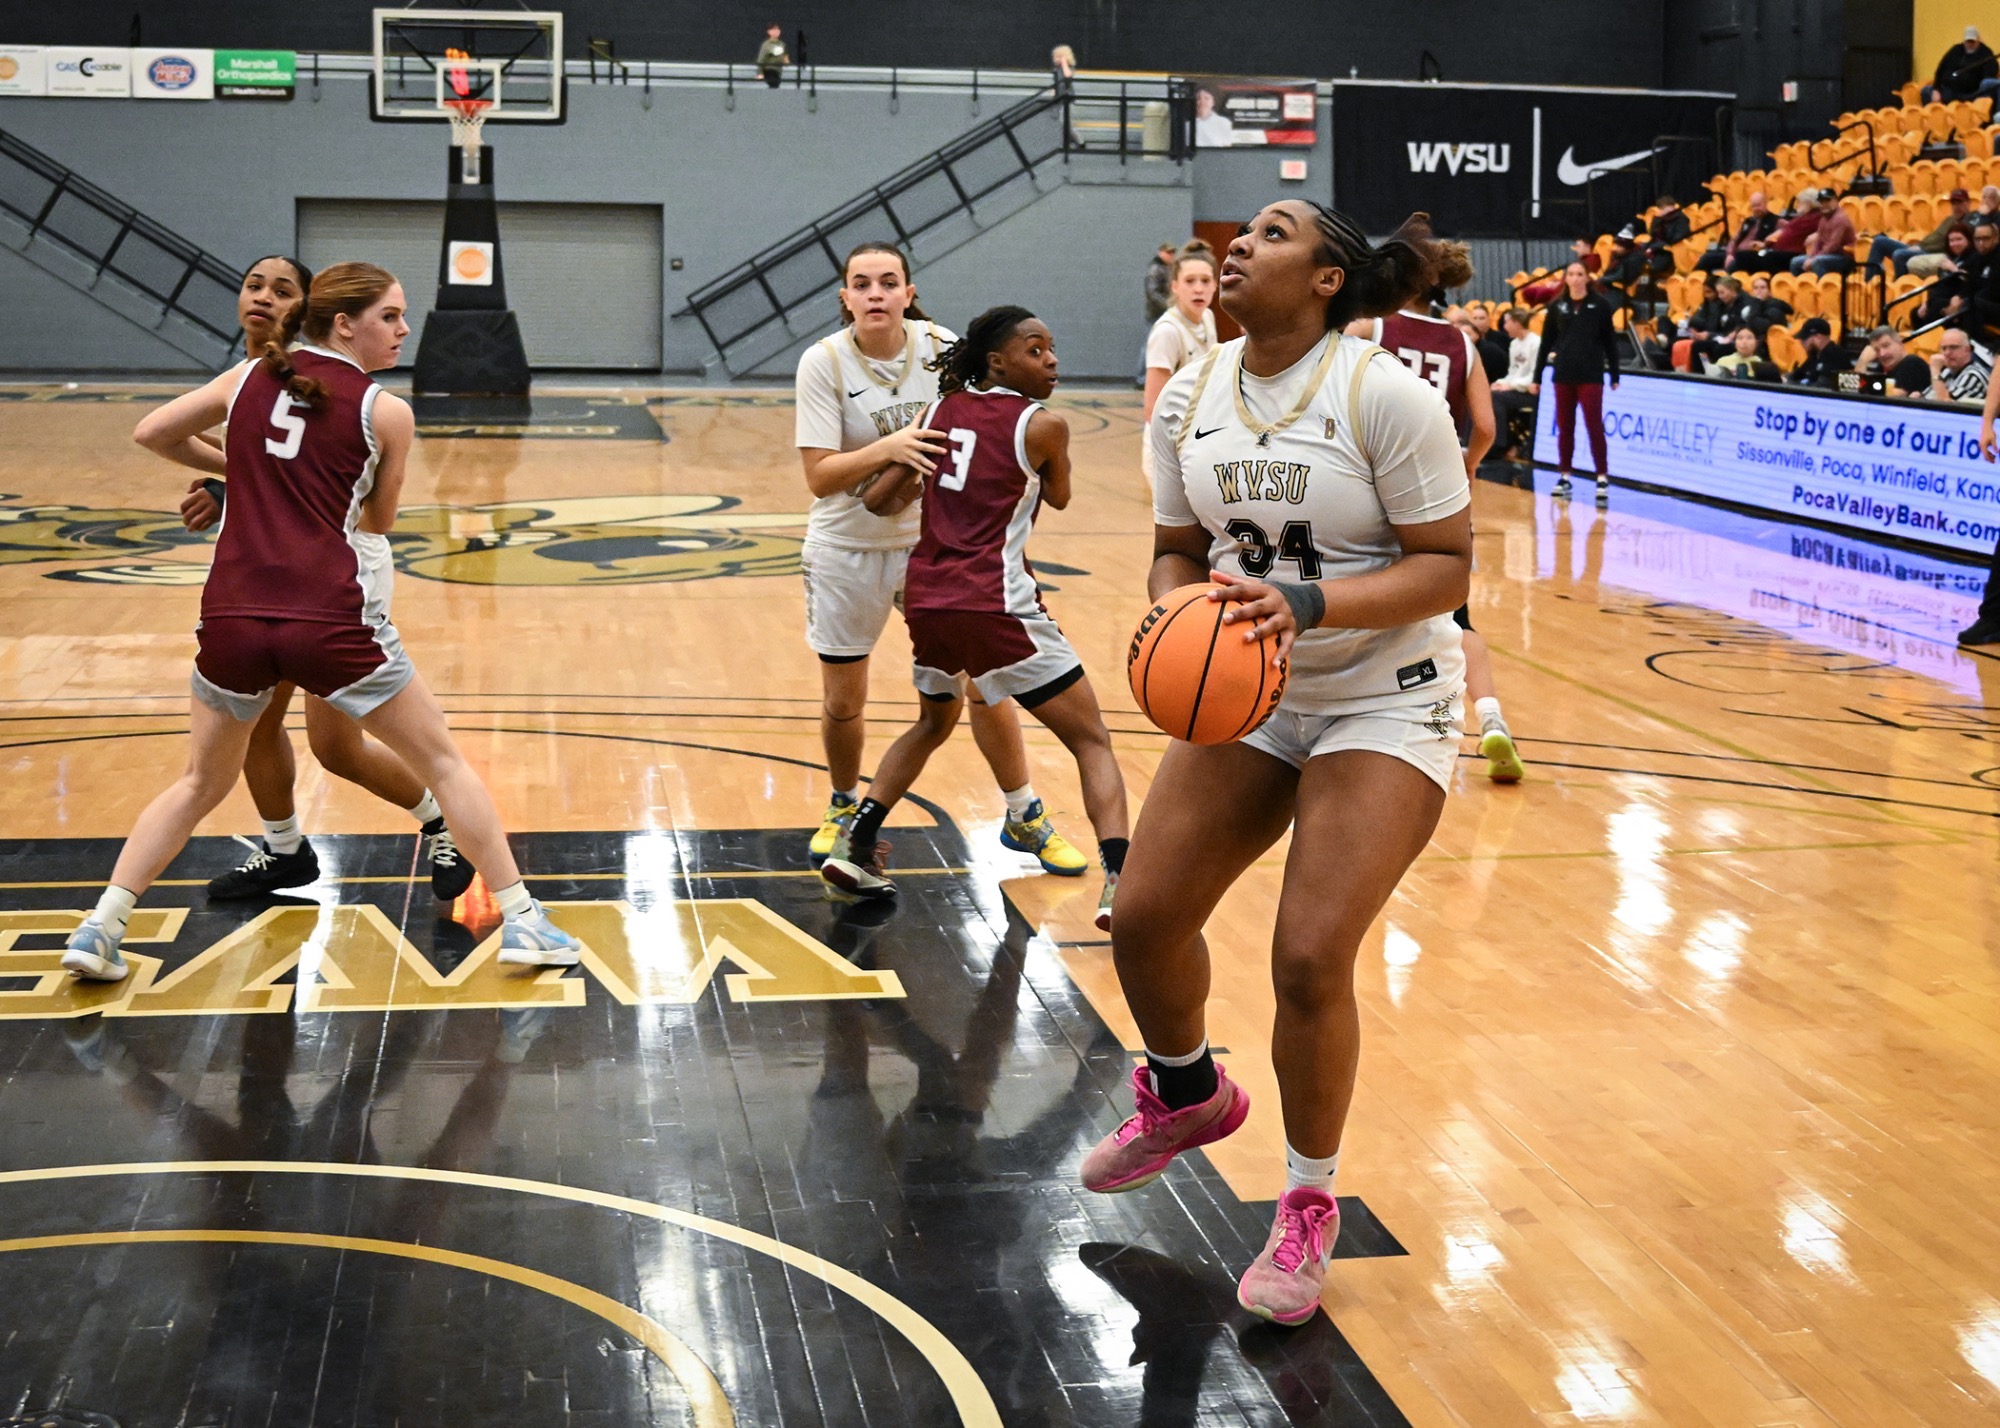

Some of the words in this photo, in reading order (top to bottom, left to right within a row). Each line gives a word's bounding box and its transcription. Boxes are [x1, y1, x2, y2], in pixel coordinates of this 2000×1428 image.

[231, 58, 278, 69] Marshall
[1407, 142, 1510, 176] WVSU
[265, 390, 311, 459] 5
[1755, 406, 1798, 440] Stop
[1804, 412, 1829, 444] by
[1835, 421, 1875, 444] one
[1882, 423, 1905, 449] of
[1911, 431, 1952, 456] our
[1958, 431, 1982, 460] lo
[939, 427, 977, 492] 3
[1214, 460, 1310, 505] WVSU
[1737, 441, 1817, 475] Sissonville,
[1822, 456, 1866, 485] Poca,
[1872, 463, 1951, 498] Winfield,
[1792, 485, 2000, 544] PocaValleyBank.com
[1225, 518, 1322, 581] 34
[1421, 666, 1434, 676] XL
